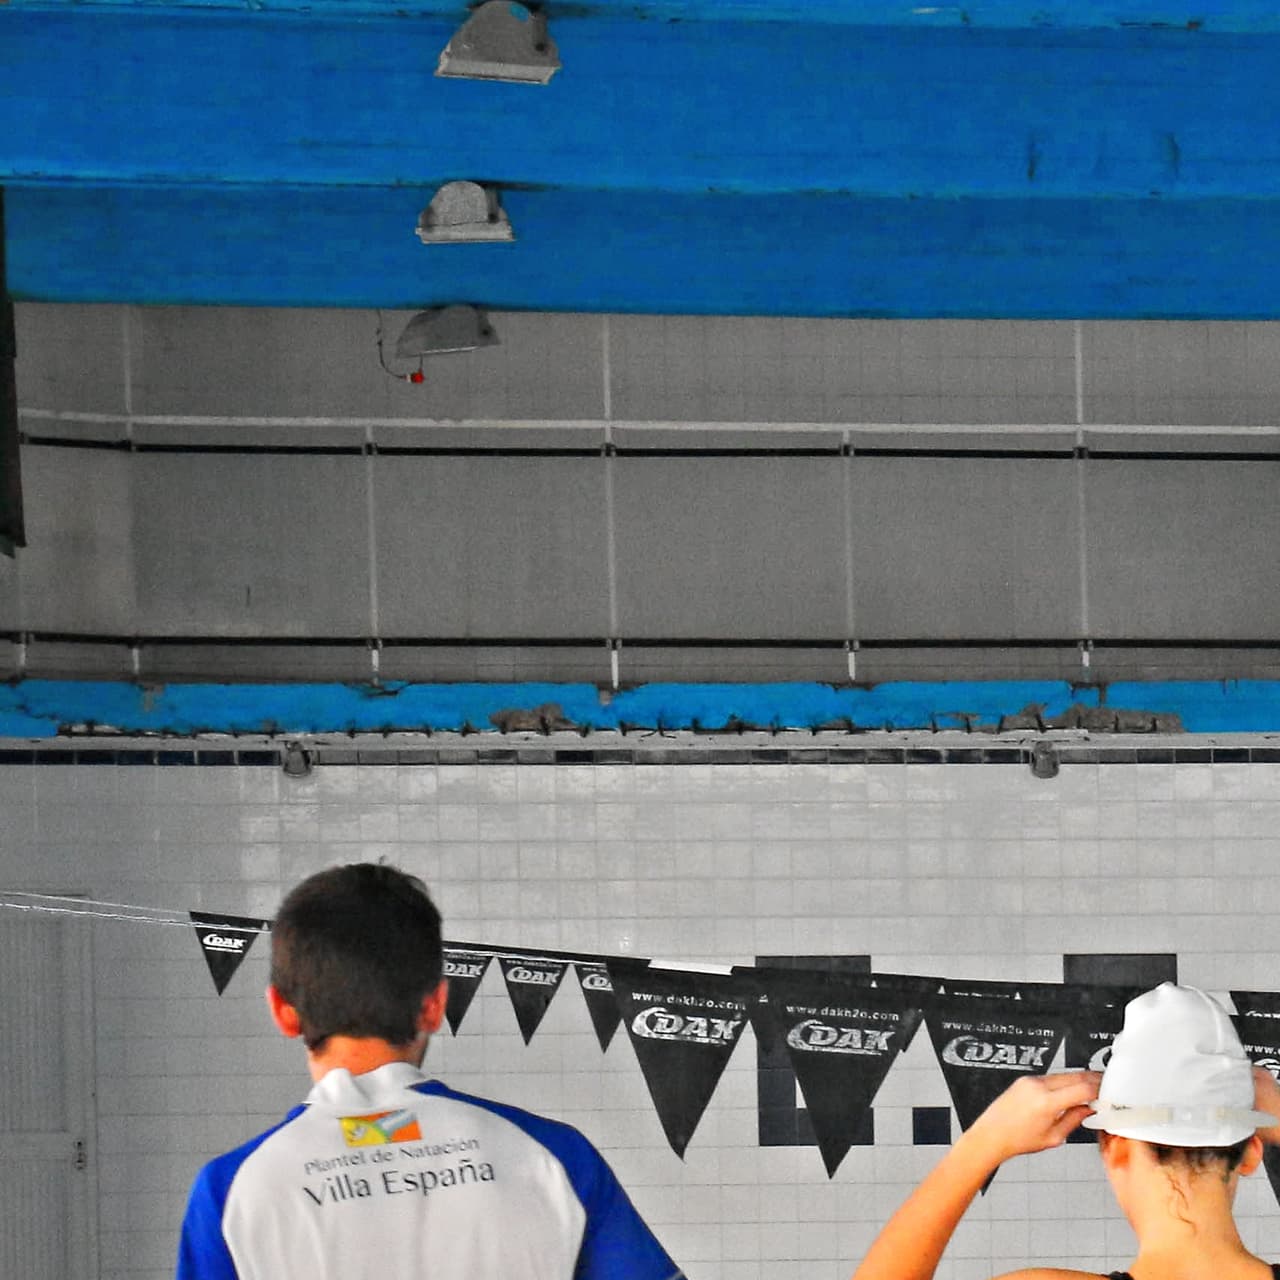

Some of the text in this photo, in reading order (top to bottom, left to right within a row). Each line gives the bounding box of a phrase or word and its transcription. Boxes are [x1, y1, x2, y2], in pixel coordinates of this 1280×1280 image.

[786, 1006, 899, 1021] wwwdakh2o.com
[304, 1138, 480, 1175] Plantel de Natación
[302, 1159, 495, 1206] Villa España
